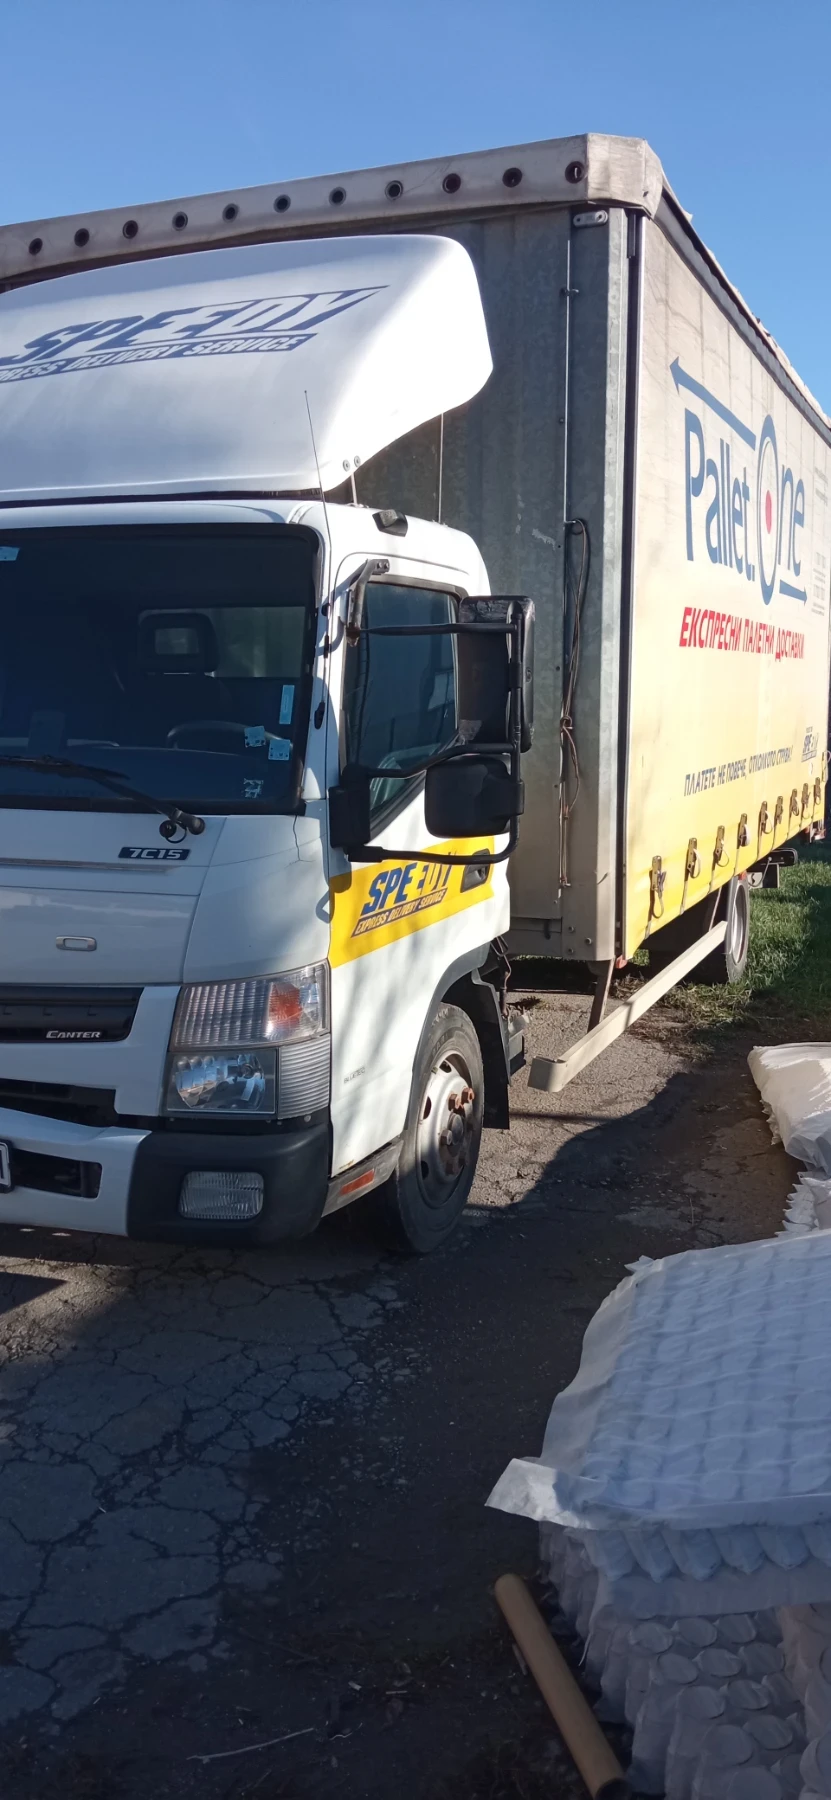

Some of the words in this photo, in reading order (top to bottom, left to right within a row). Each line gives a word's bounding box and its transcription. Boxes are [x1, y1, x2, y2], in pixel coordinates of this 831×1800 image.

[0, 284, 390, 366] SPEEDY
[61, 343, 183, 372] DELIVERY
[182, 334, 303, 356] SERVICE
[679, 607, 742, 652] ЕКСПРЕСНИ
[742, 618, 775, 655] ПАЛЕТНИ
[775, 627, 805, 663] ДОСТАВКИ
[684, 767, 716, 797] ПЛАТЕТЕ
[717, 764, 726, 786] НЕ
[129, 848, 184, 860] 7C15
[355, 914, 389, 934] EXPRESS
[387, 900, 420, 921] DELIVERY
[418, 889, 446, 909] SERVICE
